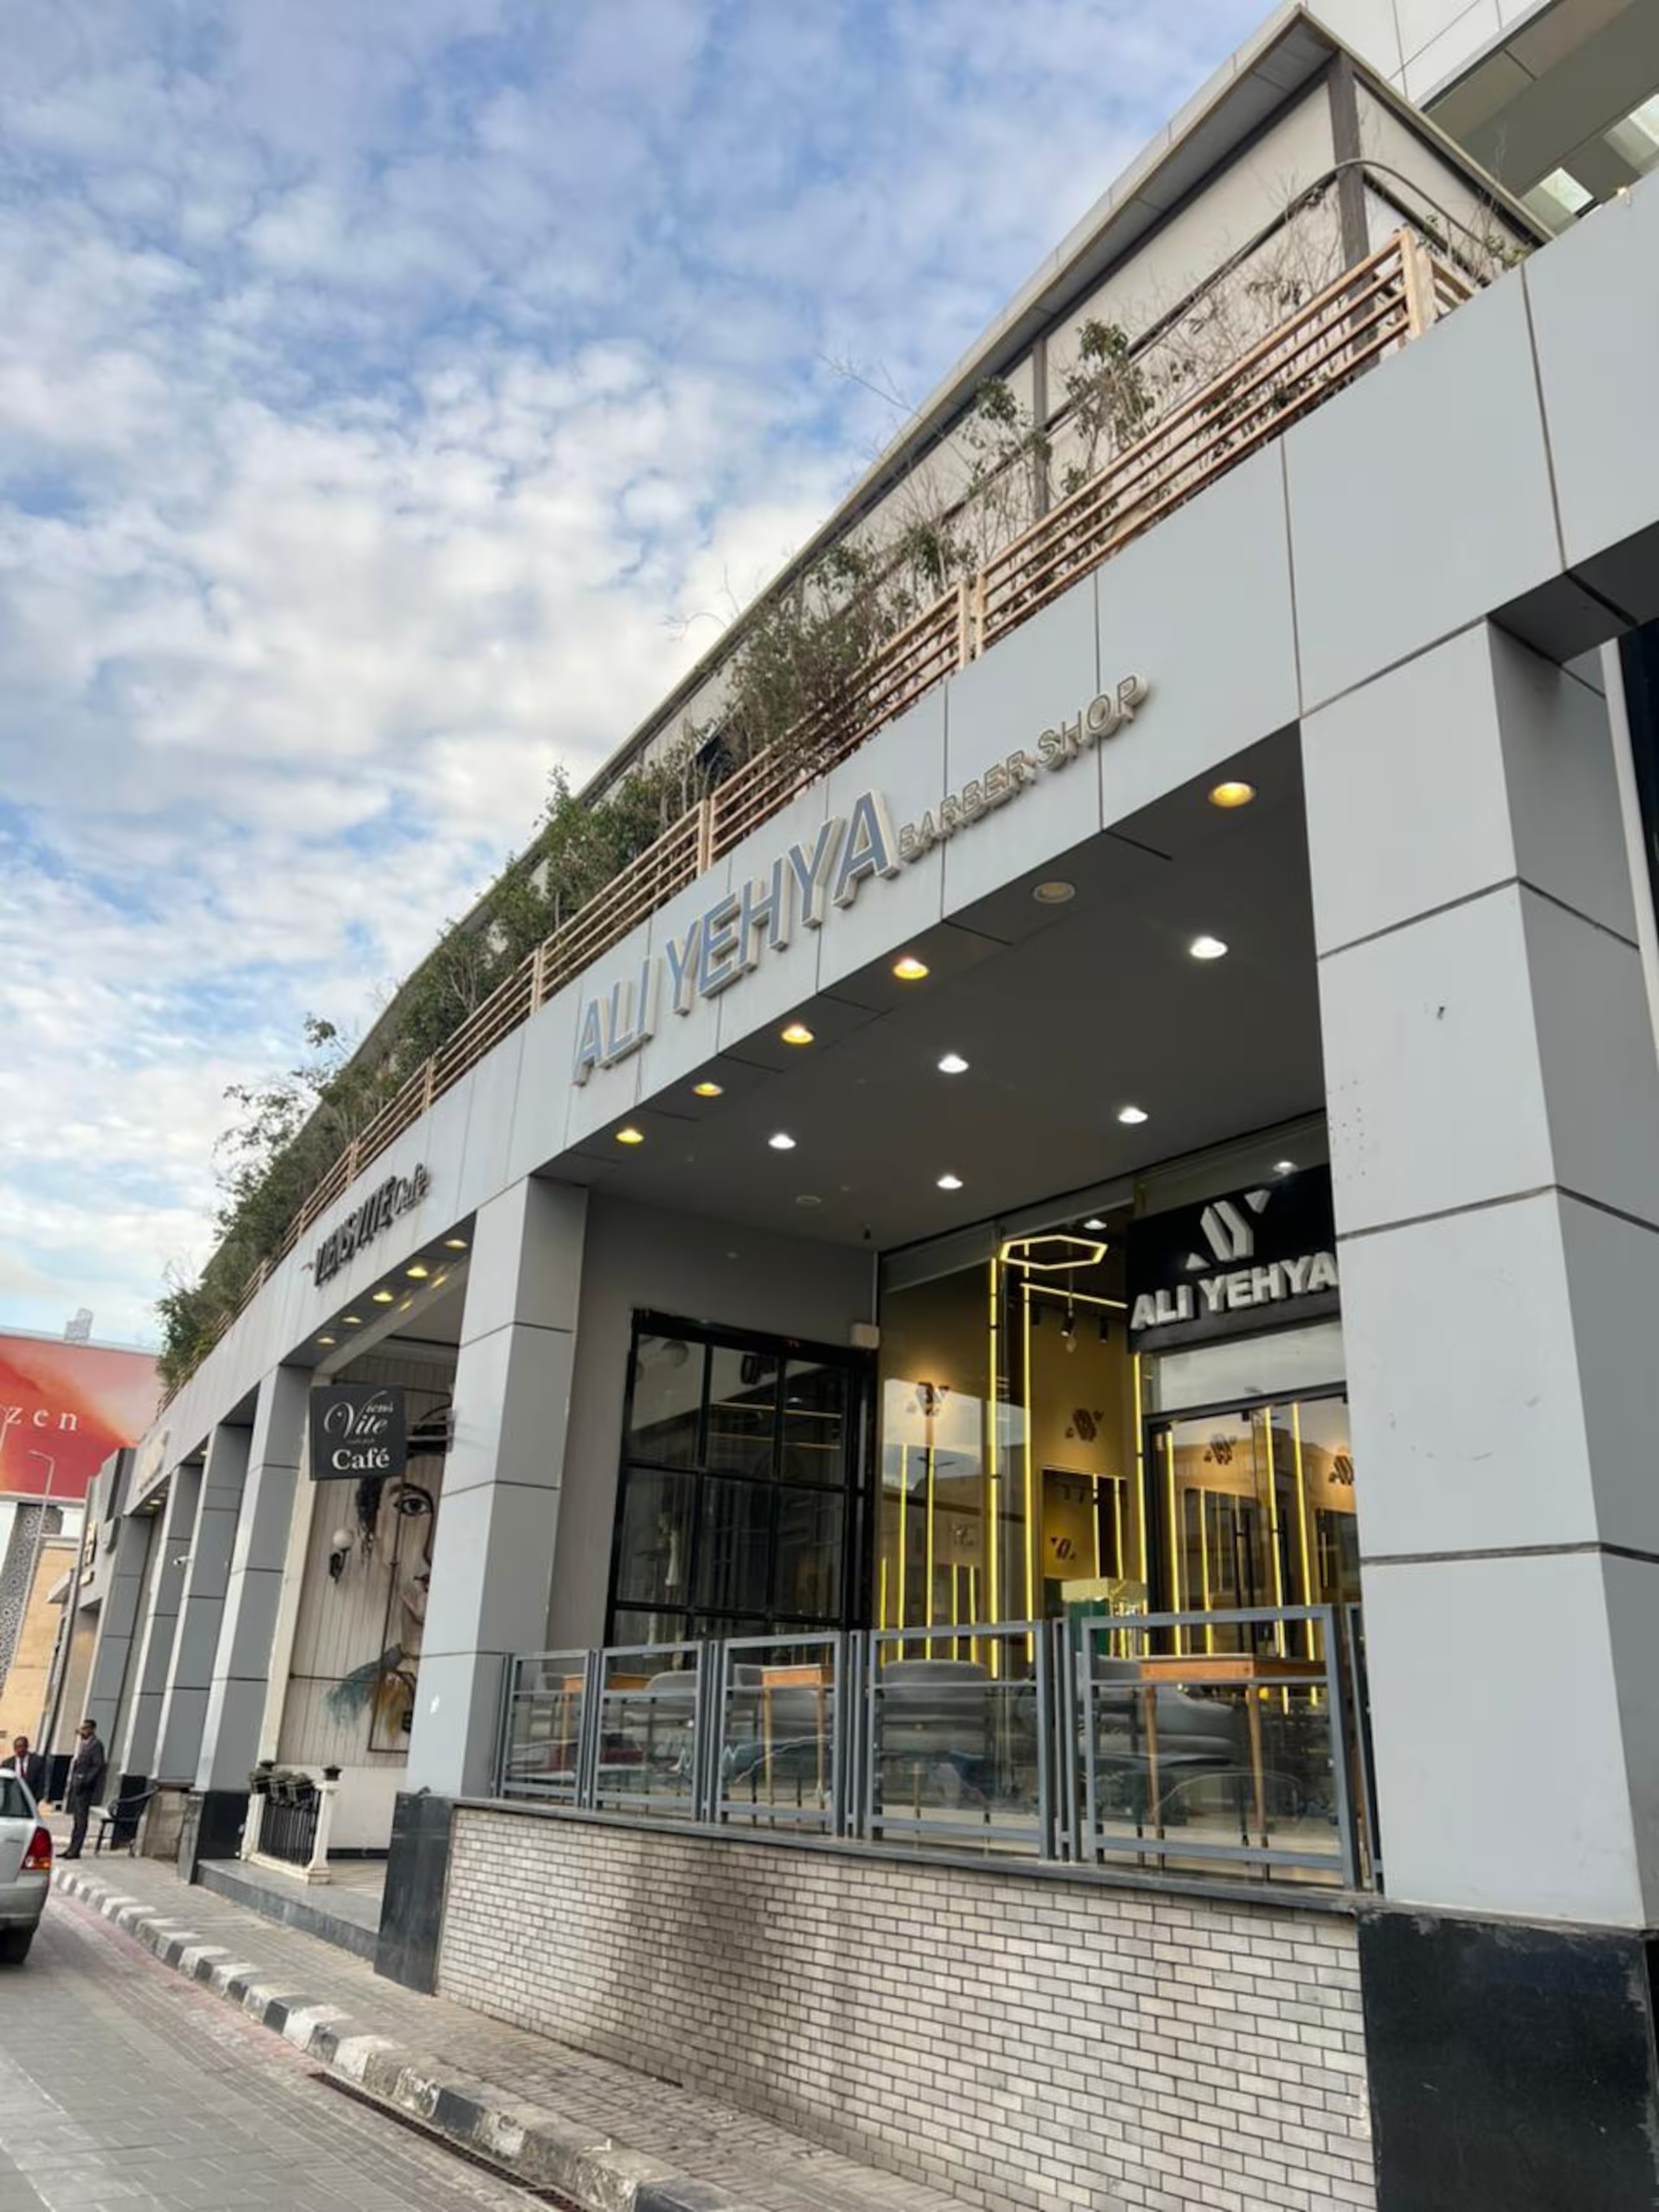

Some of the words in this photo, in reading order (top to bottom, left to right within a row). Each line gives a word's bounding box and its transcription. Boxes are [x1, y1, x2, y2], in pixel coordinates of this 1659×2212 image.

[898, 749, 1037, 863] BARBER
[1037, 673, 1150, 771] SHOP
[571, 956, 662, 1086] ALI
[666, 787, 900, 1016] YEHYA
[1130, 1285, 1194, 1329] ALI
[1198, 1252, 1338, 1312] YEHYA
[332, 1447, 390, 1470] Café
